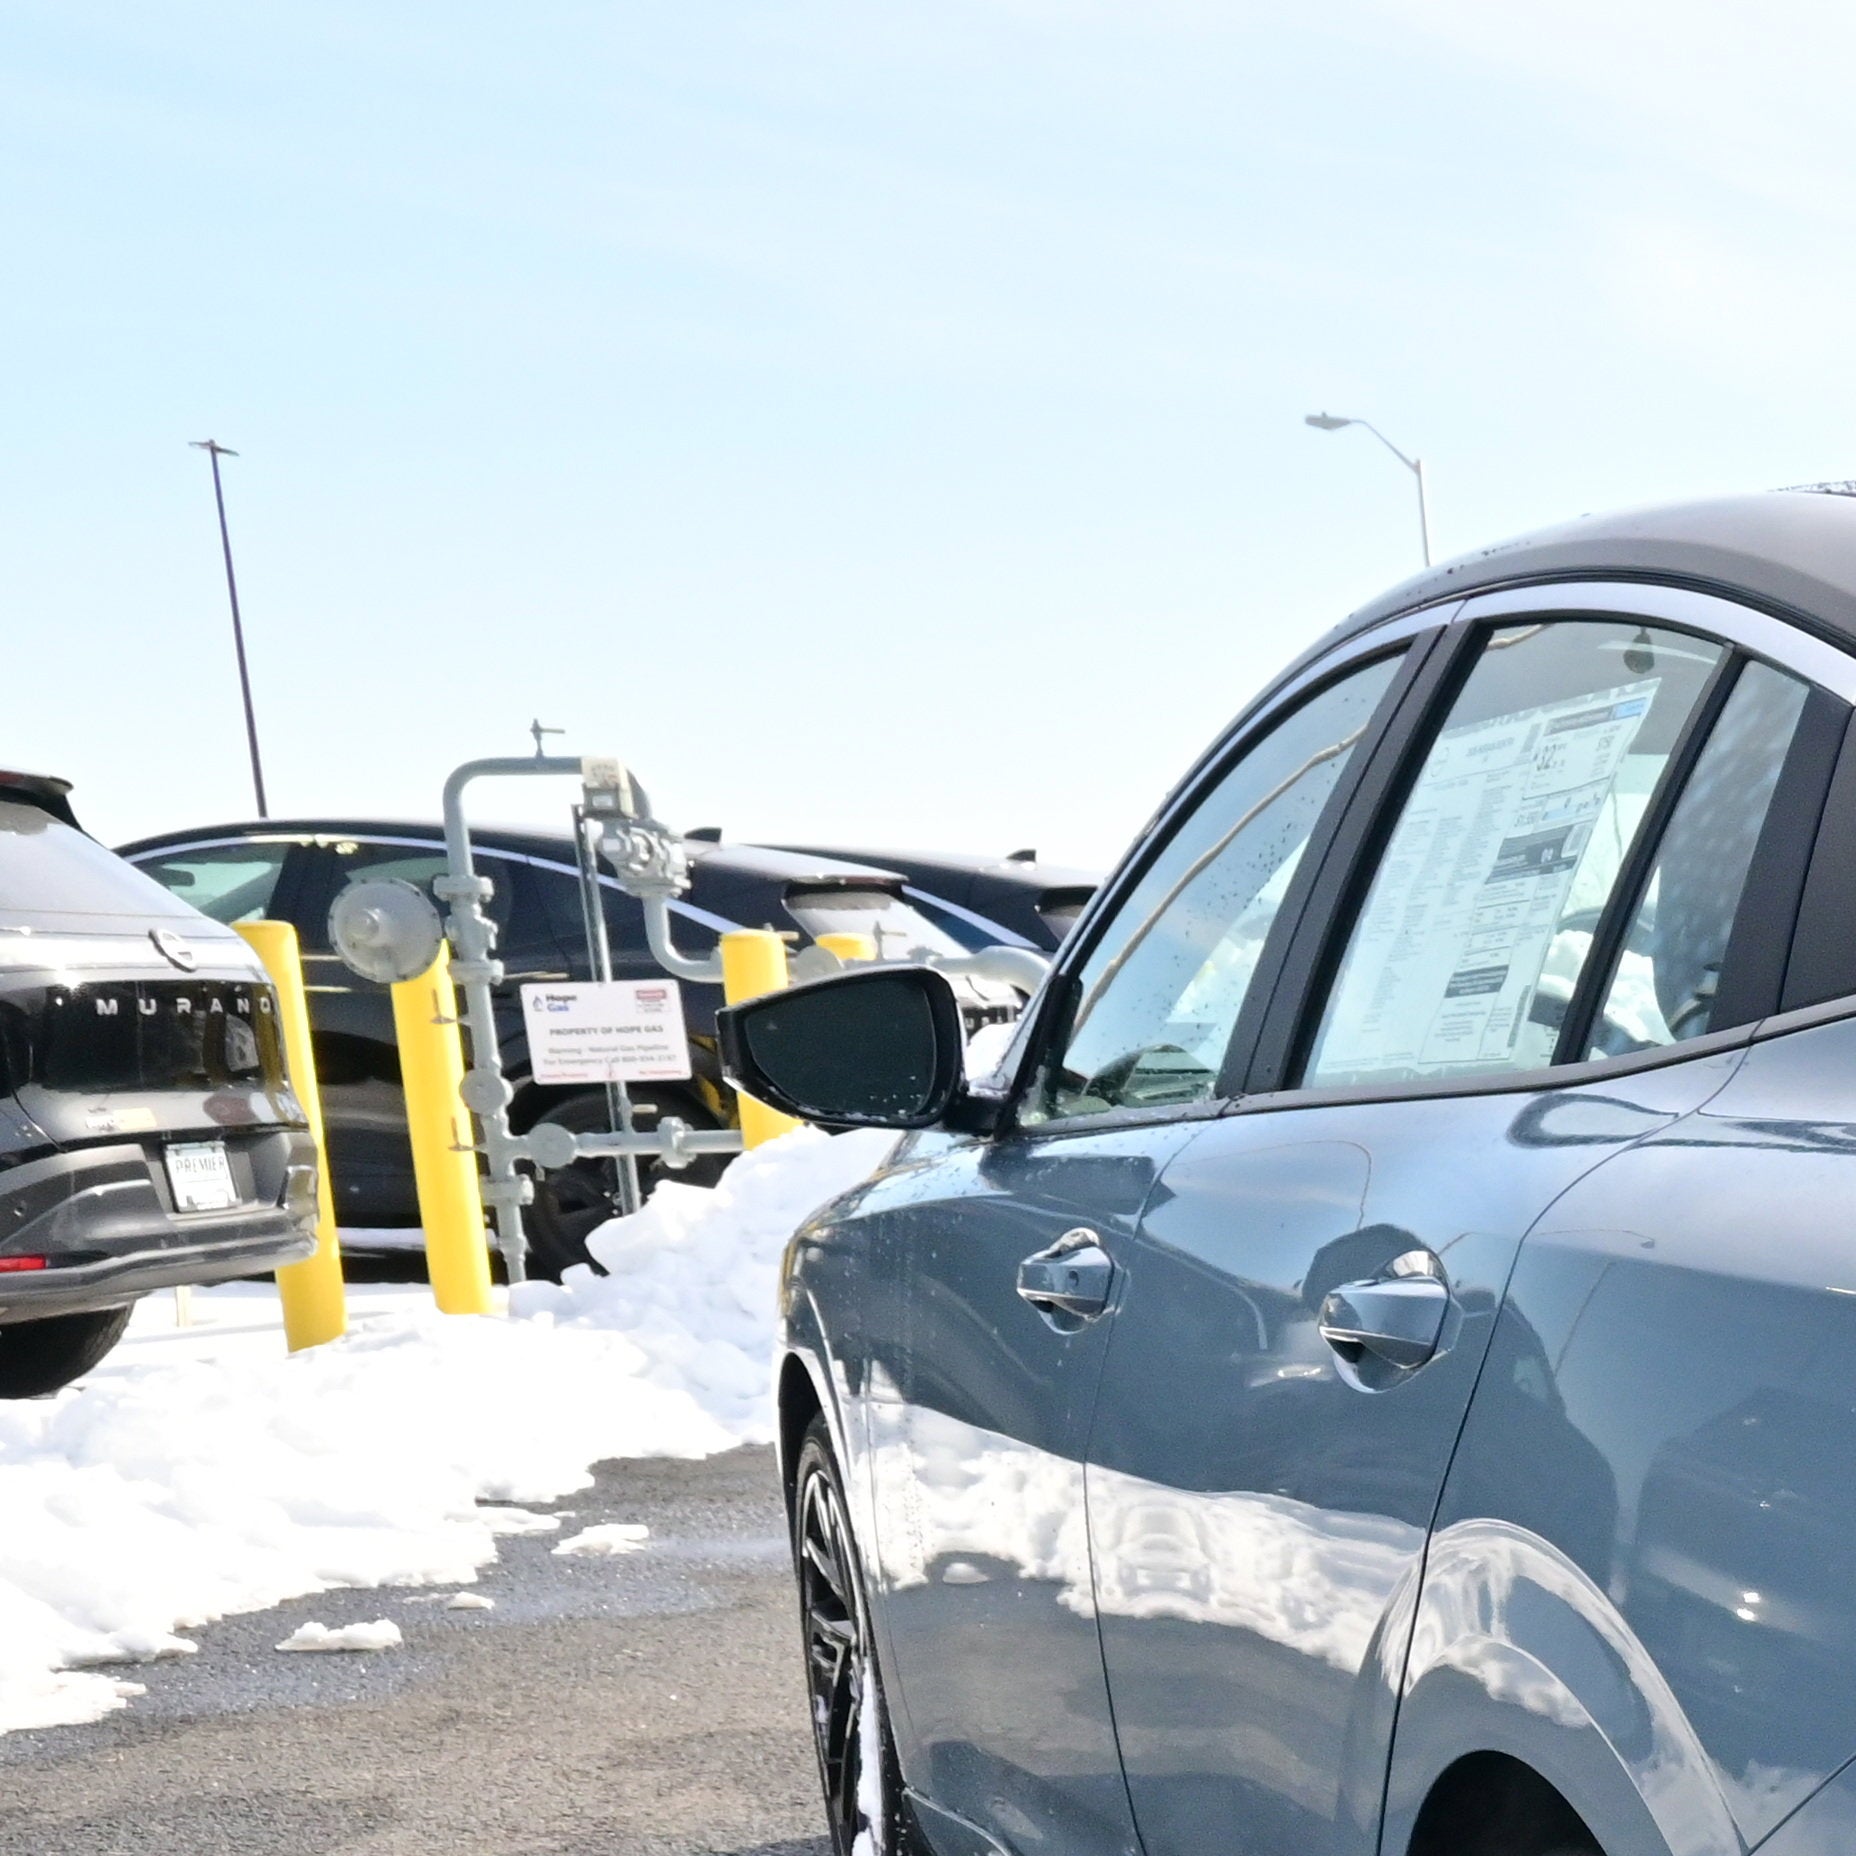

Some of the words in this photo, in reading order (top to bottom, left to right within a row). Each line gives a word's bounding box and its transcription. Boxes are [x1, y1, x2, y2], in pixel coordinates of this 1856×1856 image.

[545, 994, 577, 1003] Hope
[95, 997, 272, 1016] MURANO
[547, 1003, 569, 1012] Gas
[550, 1028, 599, 1036] PROPERTY
[616, 1026, 642, 1034] HOPE
[644, 1025, 664, 1033] GAS
